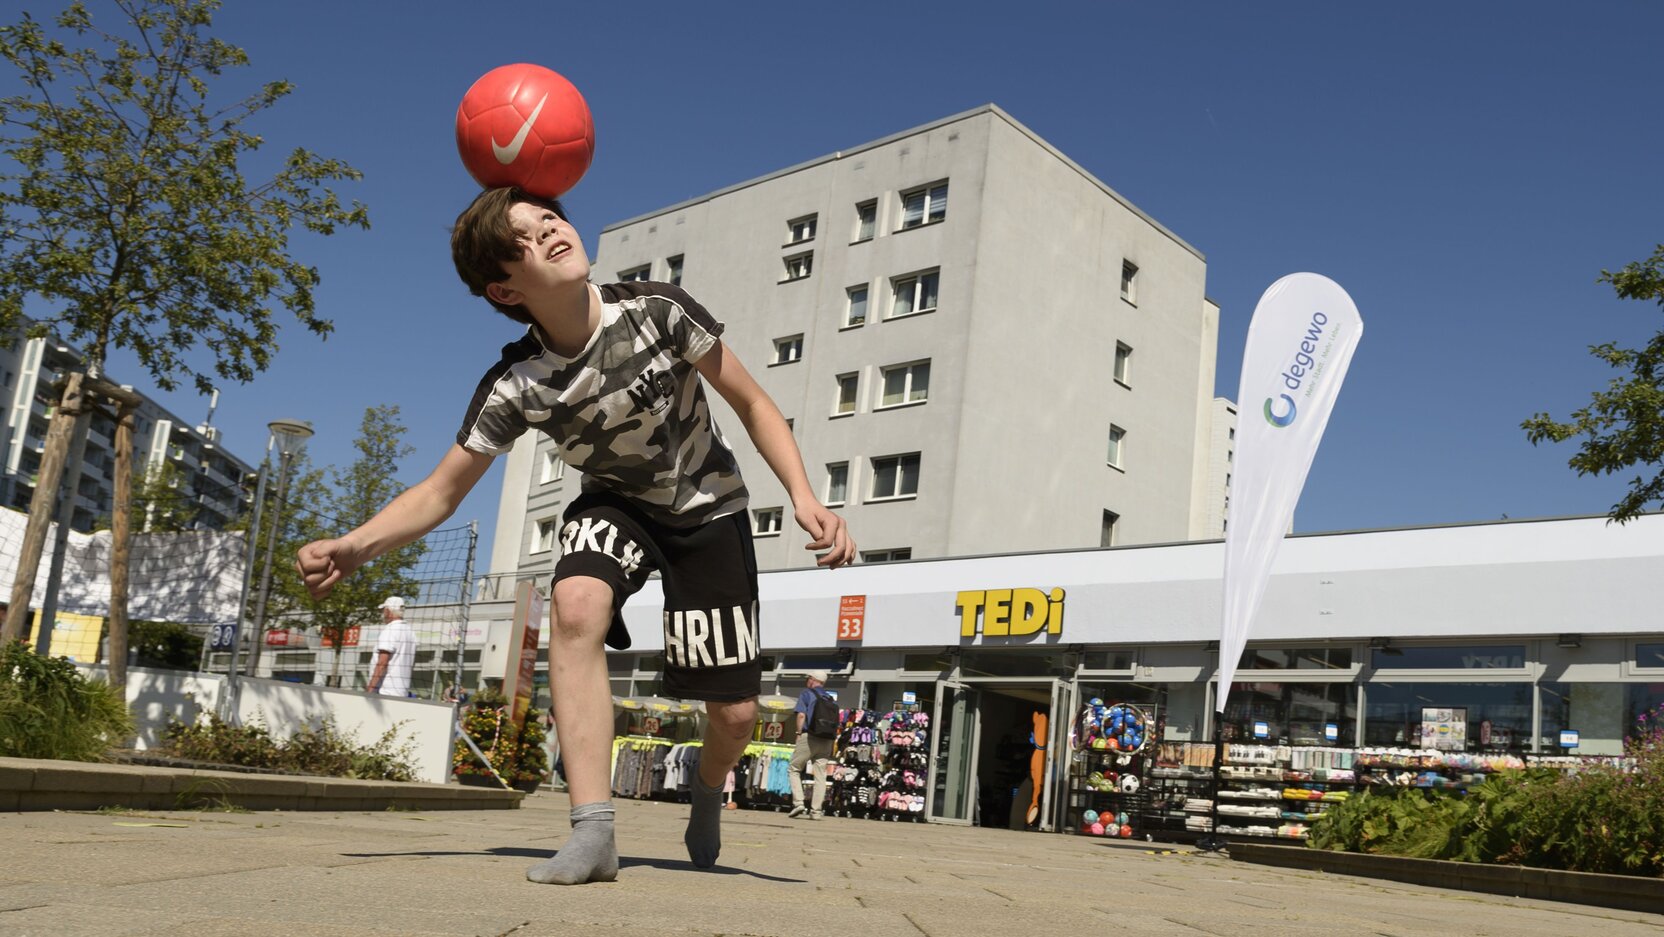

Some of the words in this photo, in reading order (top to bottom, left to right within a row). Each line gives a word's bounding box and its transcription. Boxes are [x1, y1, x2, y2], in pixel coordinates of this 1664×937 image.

[1282, 312, 1328, 390] degewo
[627, 368, 675, 412] NYC
[663, 599, 760, 668] HRLM
[840, 618, 861, 638] 33
[956, 586, 1066, 637] TEDi
